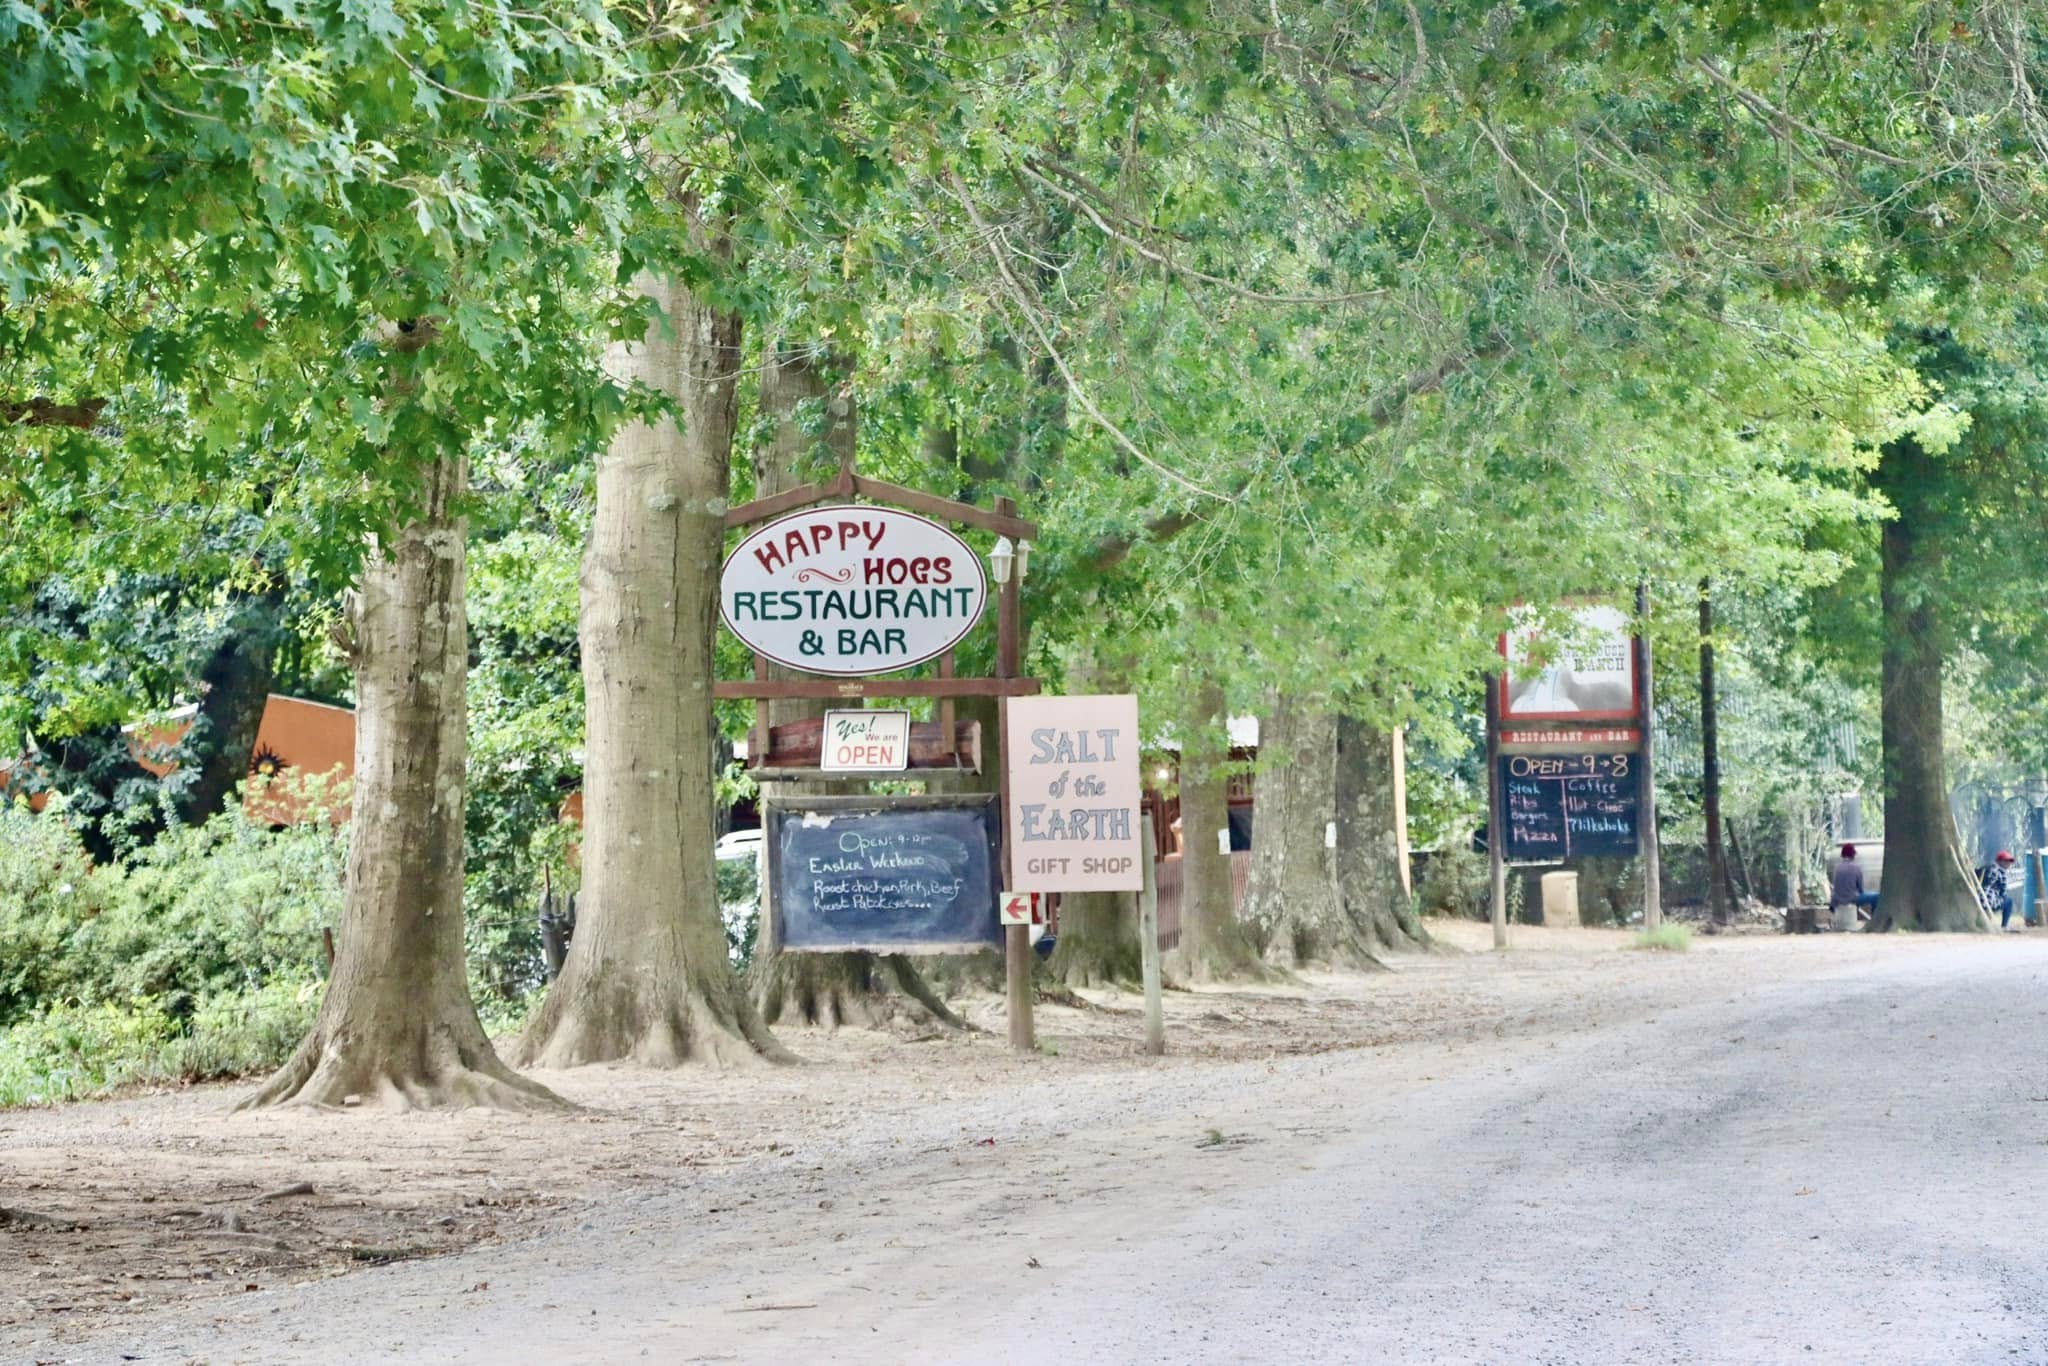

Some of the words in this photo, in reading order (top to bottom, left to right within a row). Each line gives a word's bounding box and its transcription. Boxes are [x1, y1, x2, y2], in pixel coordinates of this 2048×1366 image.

[753, 521, 886, 574] HAPPY
[864, 556, 952, 585] HOGS
[734, 588, 974, 620] RESTAURANT
[799, 629, 825, 655] &
[838, 629, 907, 655] BAR
[835, 715, 876, 741] Yes!
[865, 733, 880, 741] We
[837, 745, 893, 764] OPEN
[1030, 728, 1120, 764] SALT
[1049, 770, 1070, 798] of
[1074, 774, 1106, 797] the
[1020, 804, 1132, 842] EARTH
[1027, 858, 1071, 875] GIFT
[1083, 857, 1132, 874] SHOP
